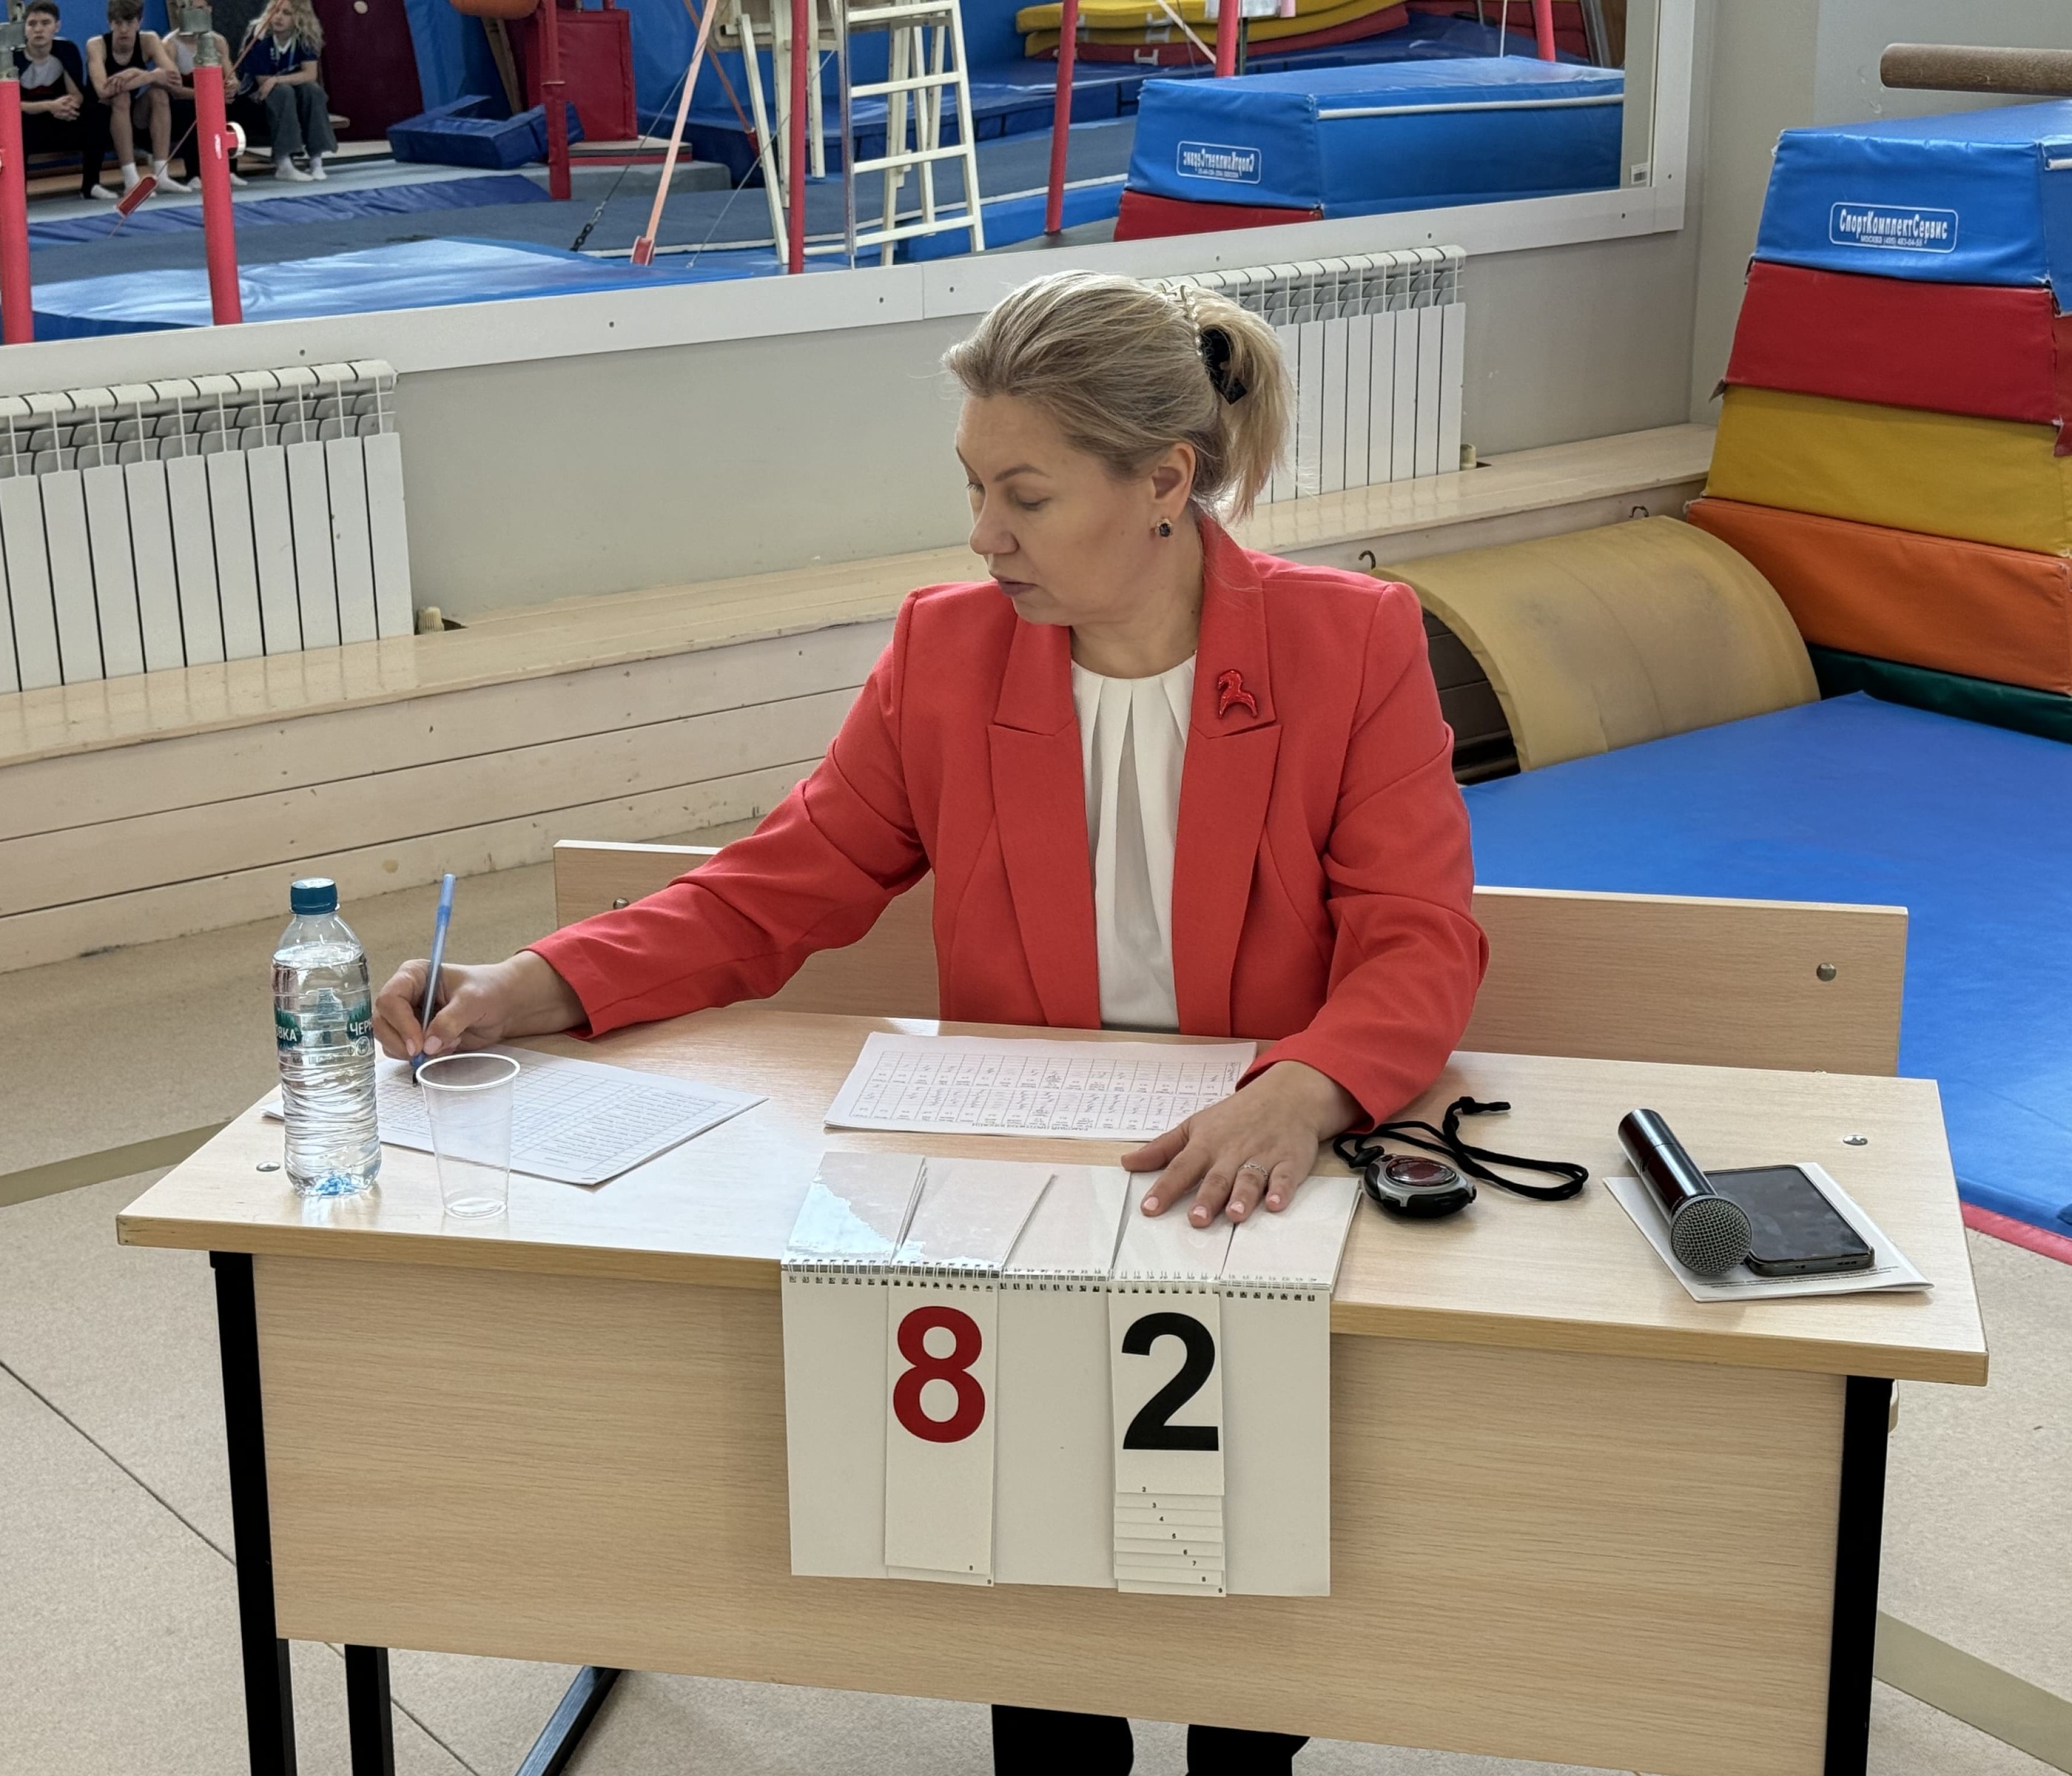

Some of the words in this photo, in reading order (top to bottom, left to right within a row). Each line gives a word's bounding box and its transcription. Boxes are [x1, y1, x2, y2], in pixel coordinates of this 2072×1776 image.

[1840, 209, 1948, 244] СпортКомплектСервис
[1860, 235, 1883, 244] МОСКВА
[275, 1024, 297, 1041] ВКА
[893, 1305, 986, 1443] 8
[1121, 1312, 1219, 1451] 2
